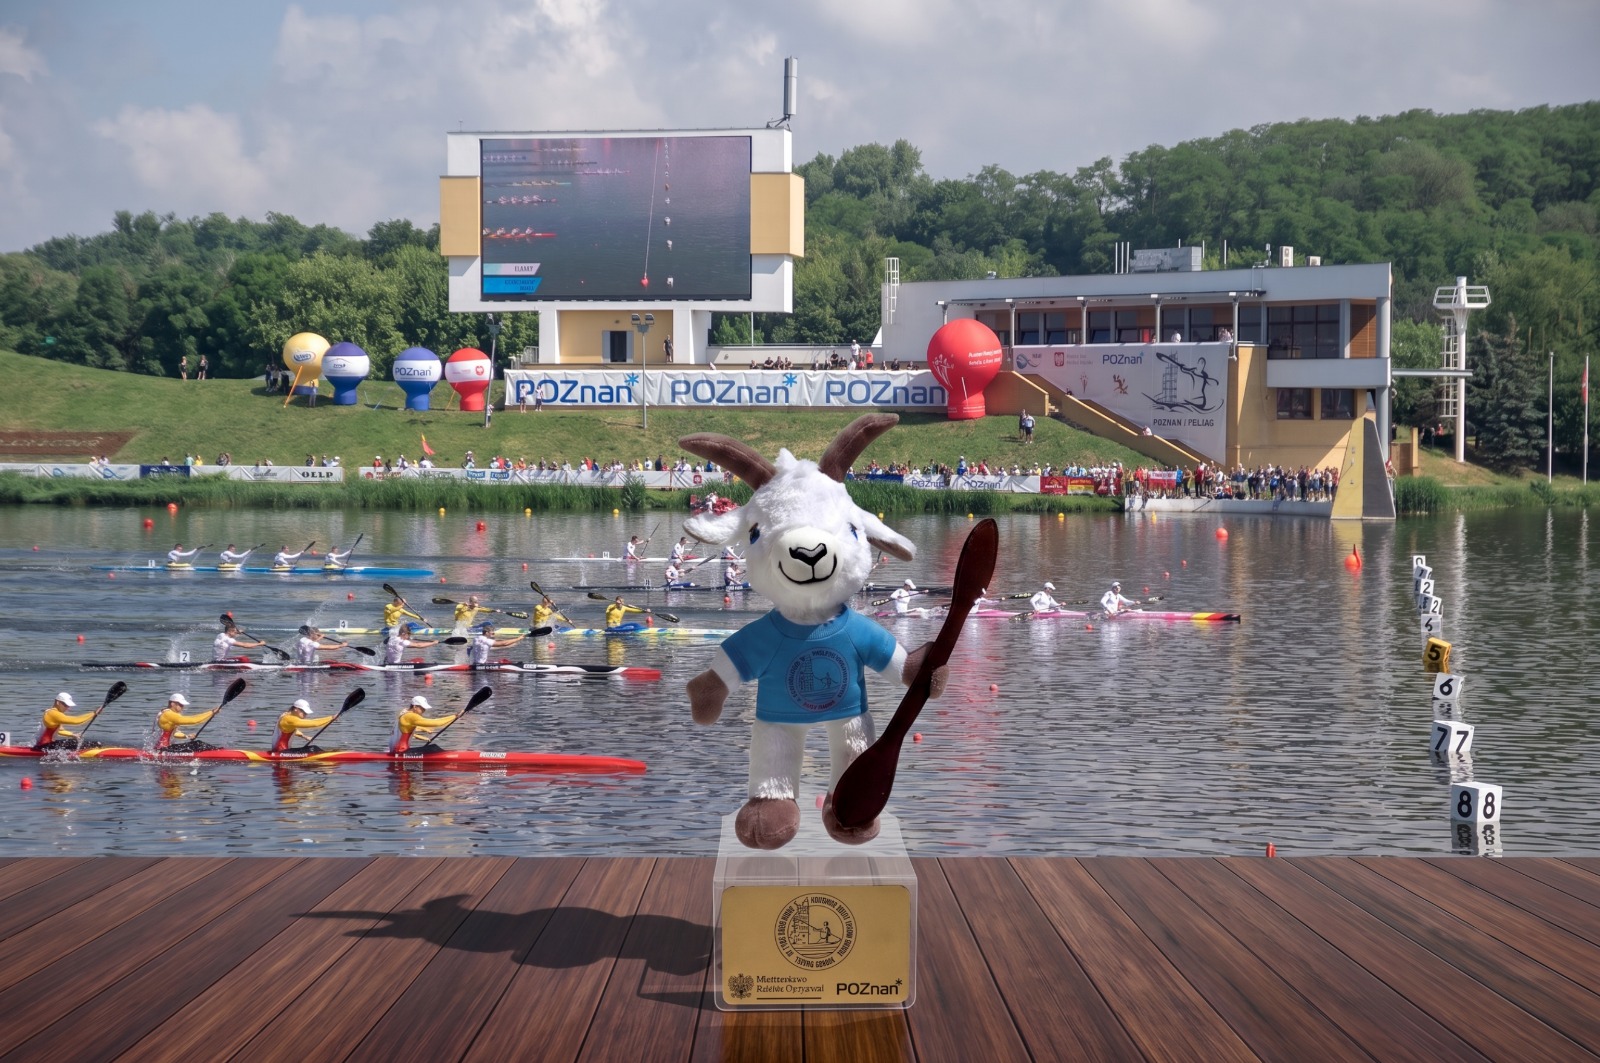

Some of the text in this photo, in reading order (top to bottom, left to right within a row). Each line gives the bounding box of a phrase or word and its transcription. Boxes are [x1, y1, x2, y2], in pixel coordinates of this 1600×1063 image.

[515, 379, 632, 403] POZnan
[670, 379, 789, 403] POZnan
[825, 379, 946, 404] POZnan
[1423, 581, 1431, 594] 2
[1431, 600, 1439, 613] 2
[1428, 644, 1442, 661] 5
[1439, 678, 1454, 696] 6
[1434, 726, 1469, 752] 7 7
[1457, 790, 1496, 819] 8 8
[836, 982, 898, 995] POZnan
